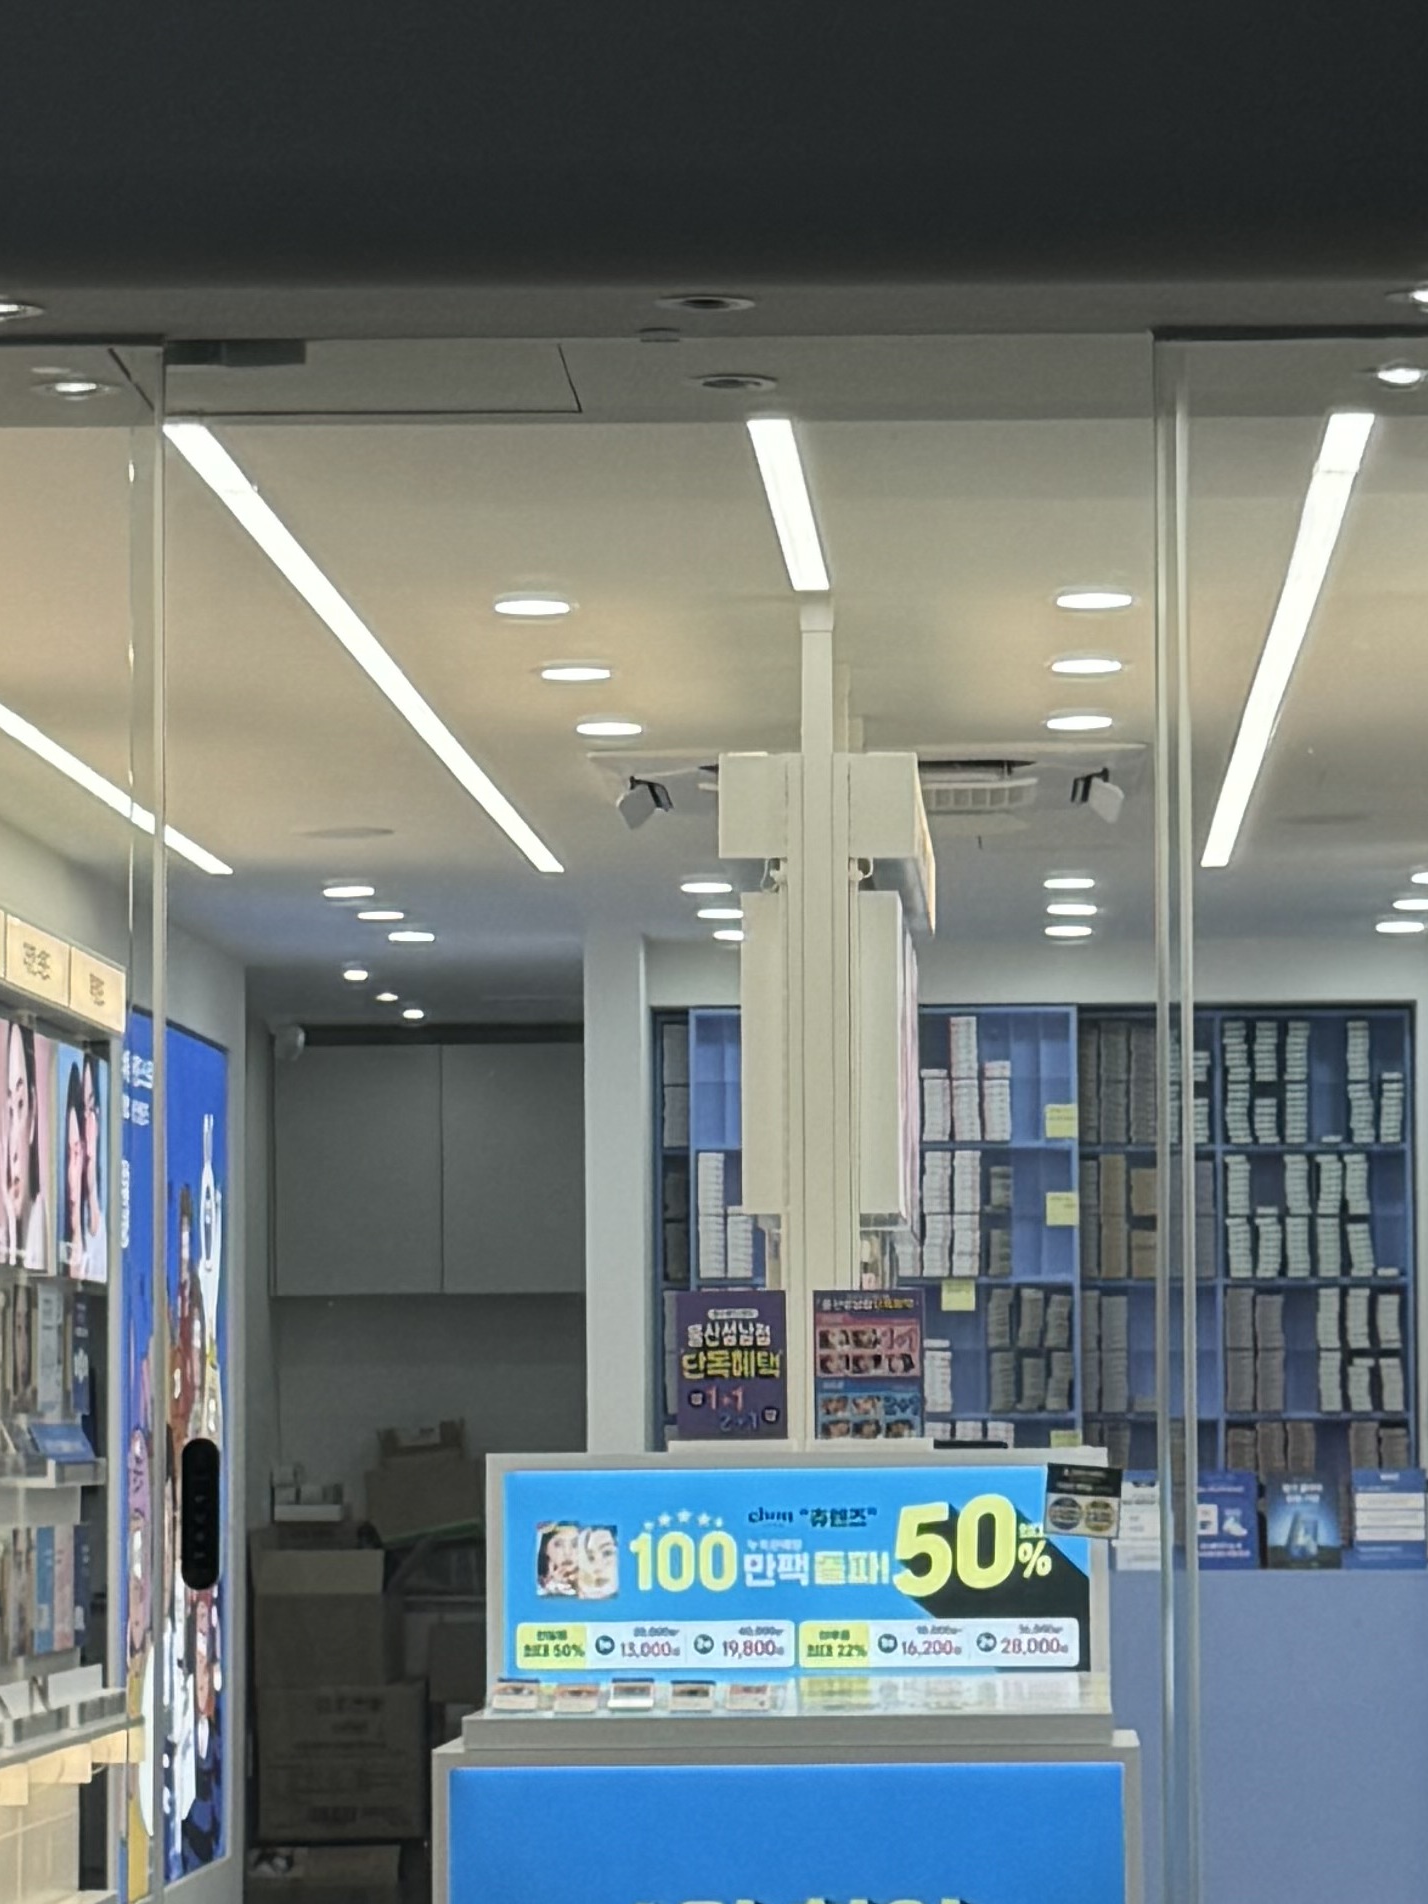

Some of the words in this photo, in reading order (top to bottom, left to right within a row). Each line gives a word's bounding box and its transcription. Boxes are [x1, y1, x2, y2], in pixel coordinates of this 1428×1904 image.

[681, 1349, 781, 1380] 단독혜택
[629, 1530, 738, 1593] 100
[743, 1551, 810, 1588] 만팩
